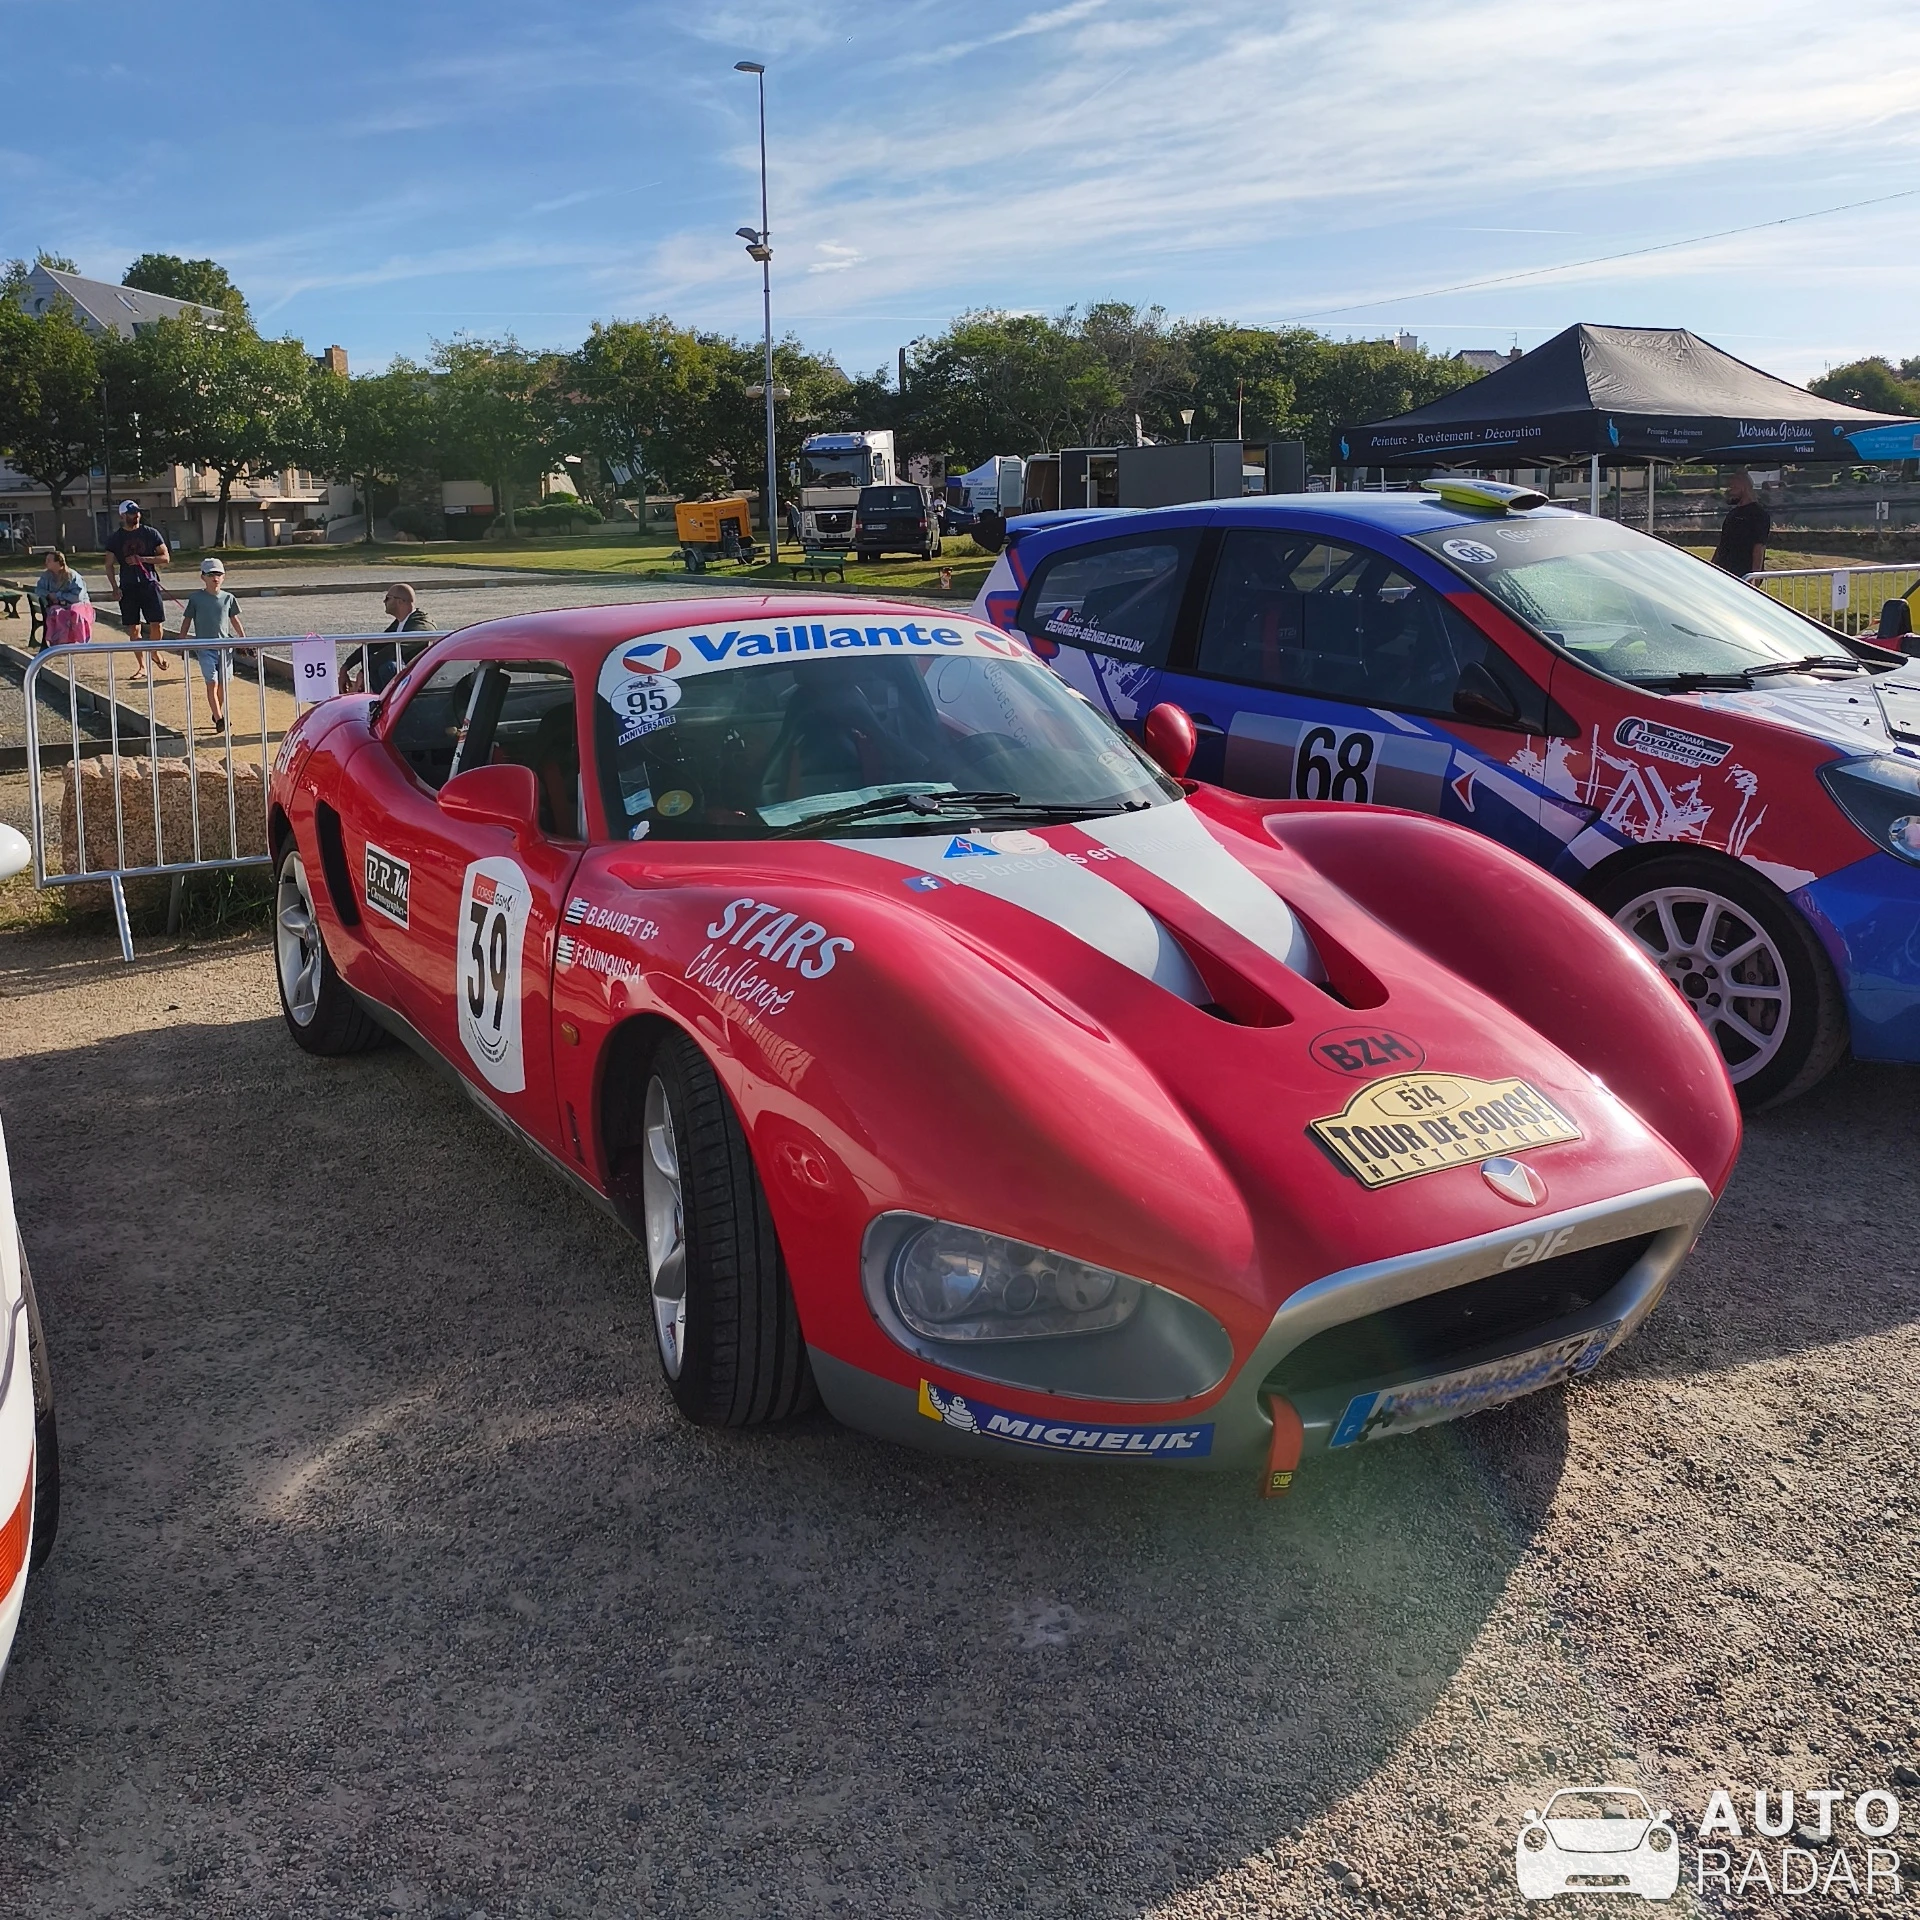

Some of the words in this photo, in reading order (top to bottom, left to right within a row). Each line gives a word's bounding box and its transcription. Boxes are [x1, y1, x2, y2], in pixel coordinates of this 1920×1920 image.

[1371, 435, 1407, 447] Peinture
[1417, 430, 1474, 444] Revêtement
[1484, 425, 1542, 440] Décoration
[1793, 445, 1815, 453] Artisan
[850, 476, 862, 485] TIR
[1457, 546, 1495, 563] 96
[1837, 584, 1847, 595] 98
[689, 623, 965, 662] Vaillante
[304, 662, 327, 678] 95
[626, 689, 668, 716] 95
[619, 715, 676, 745] ANNIVERSAIRE
[1004, 708, 1019, 727] DE
[1634, 731, 1722, 765] ToyoRacing
[1665, 729, 1705, 747] YOKOHAMA
[1296, 726, 1374, 804] 68
[1087, 845, 1125, 861] en
[476, 884, 495, 903] CORSE
[585, 906, 645, 937] B.BAUDET
[639, 920, 660, 940] B+
[706, 897, 855, 979] STARS
[467, 901, 508, 1032] 39
[575, 944, 632, 980] F.QUINQUIS
[684, 943, 796, 1025] Challenge
[1319, 1033, 1416, 1072] BZH
[1395, 1084, 1447, 1112] 514
[1326, 1121, 1422, 1164] TOUR
[1418, 1116, 1469, 1145] DE
[1458, 1086, 1560, 1135] CORSE
[1365, 1120, 1571, 1179] HISTORIQUE
[1502, 1225, 1576, 1269] elf
[1578, 1350, 1597, 1370] 22
[1273, 1474, 1293, 1485] OMP
